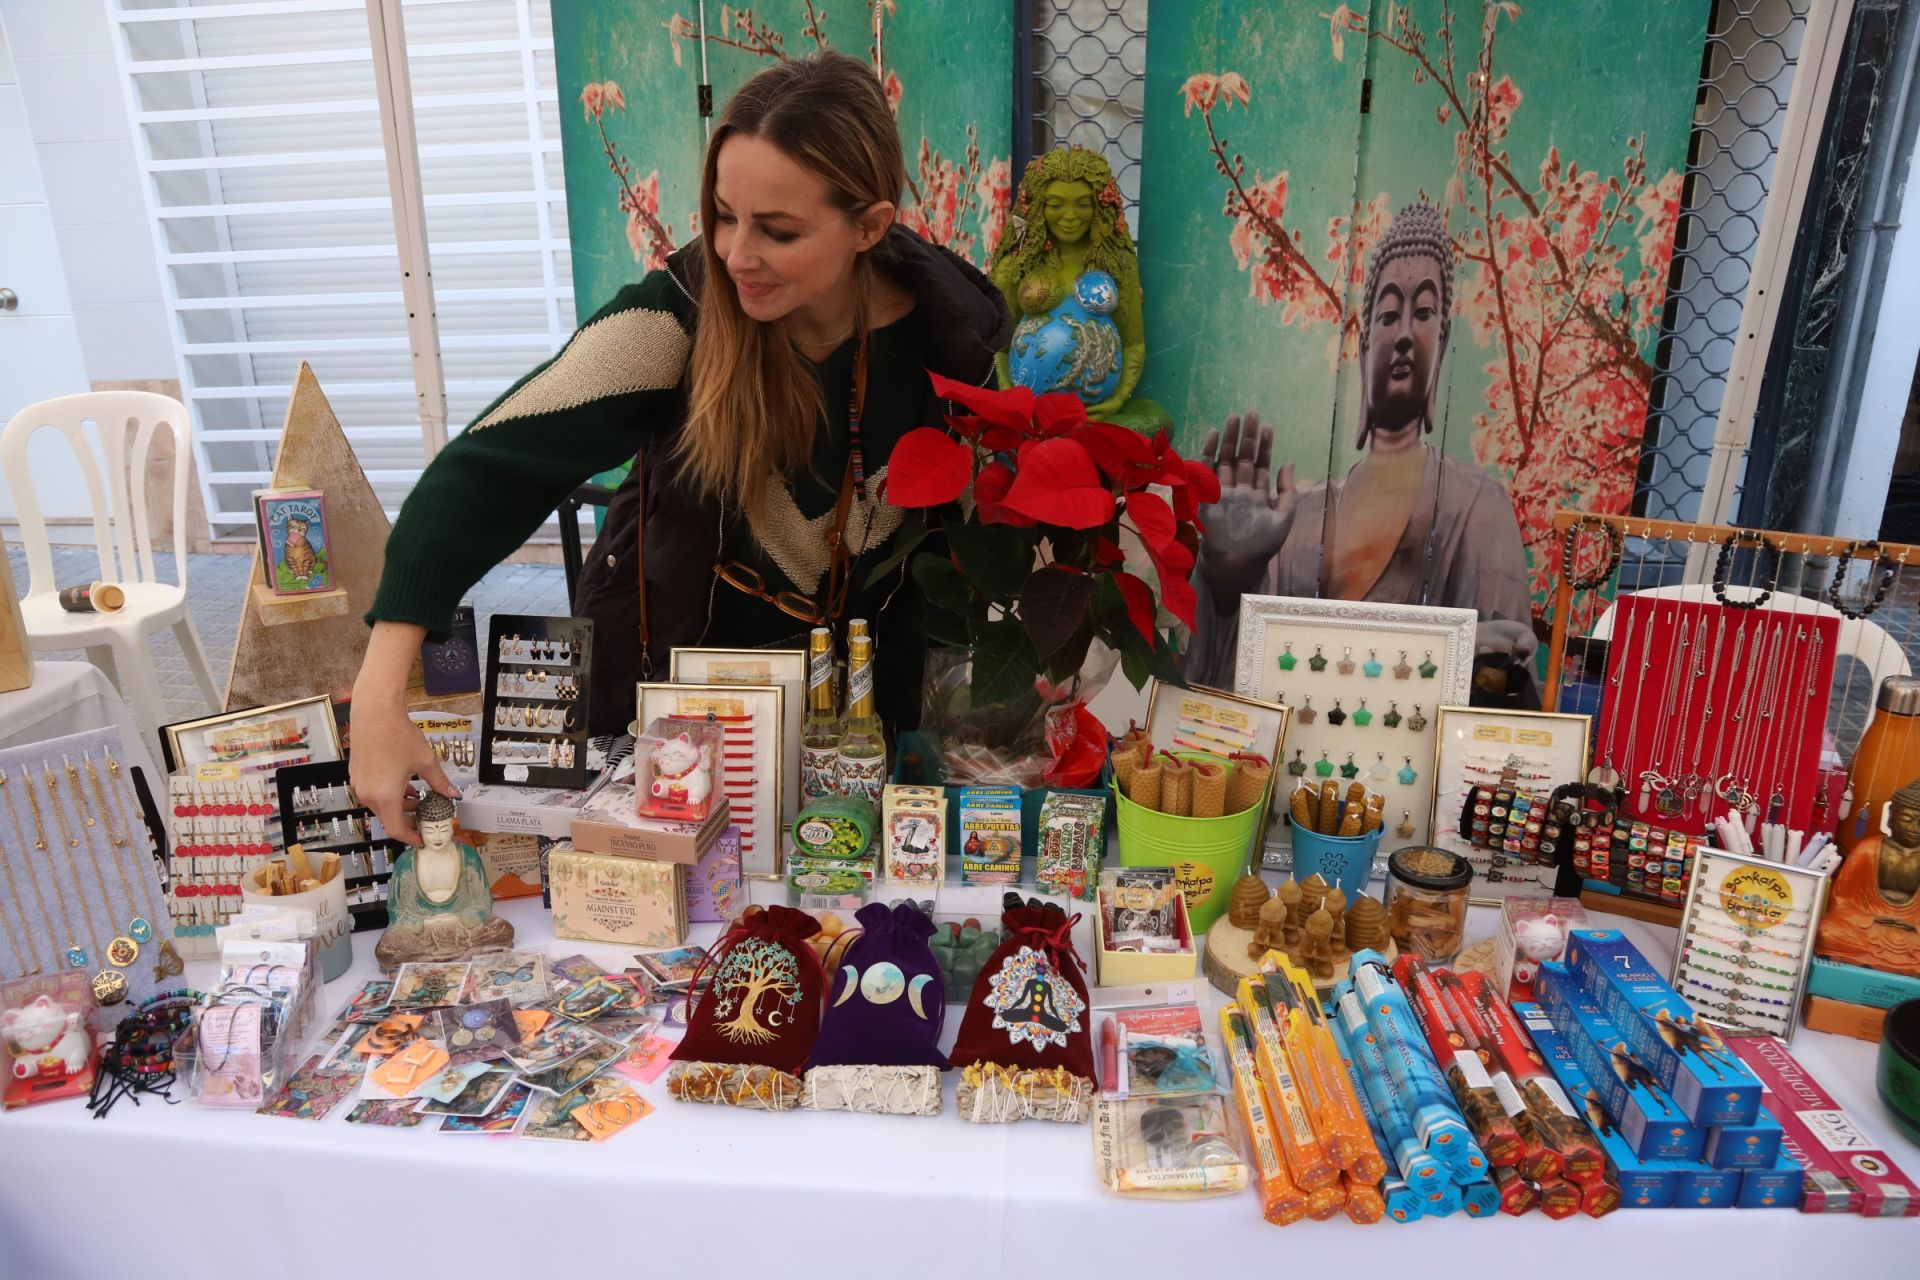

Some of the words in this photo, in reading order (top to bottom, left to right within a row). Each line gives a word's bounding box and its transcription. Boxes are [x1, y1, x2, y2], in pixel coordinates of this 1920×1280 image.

[271, 506, 286, 523] CAT
[288, 504, 319, 521] TAROT
[496, 816, 520, 826] LLAMA
[521, 818, 542, 827] PLATA
[964, 822, 985, 830] ABRE
[986, 823, 1020, 831] PUERTAS
[803, 825, 831, 839] Trio
[610, 838, 638, 849] INCENSO
[639, 841, 656, 851] PURO
[984, 864, 1020, 872] CAMINOS
[586, 903, 619, 915] AGAINST
[619, 905, 638, 916] EVIL
[1613, 955, 1631, 969] 7
[1752, 1040, 1829, 1108] MEDITATION
[1819, 1112, 1866, 1147] NAG
